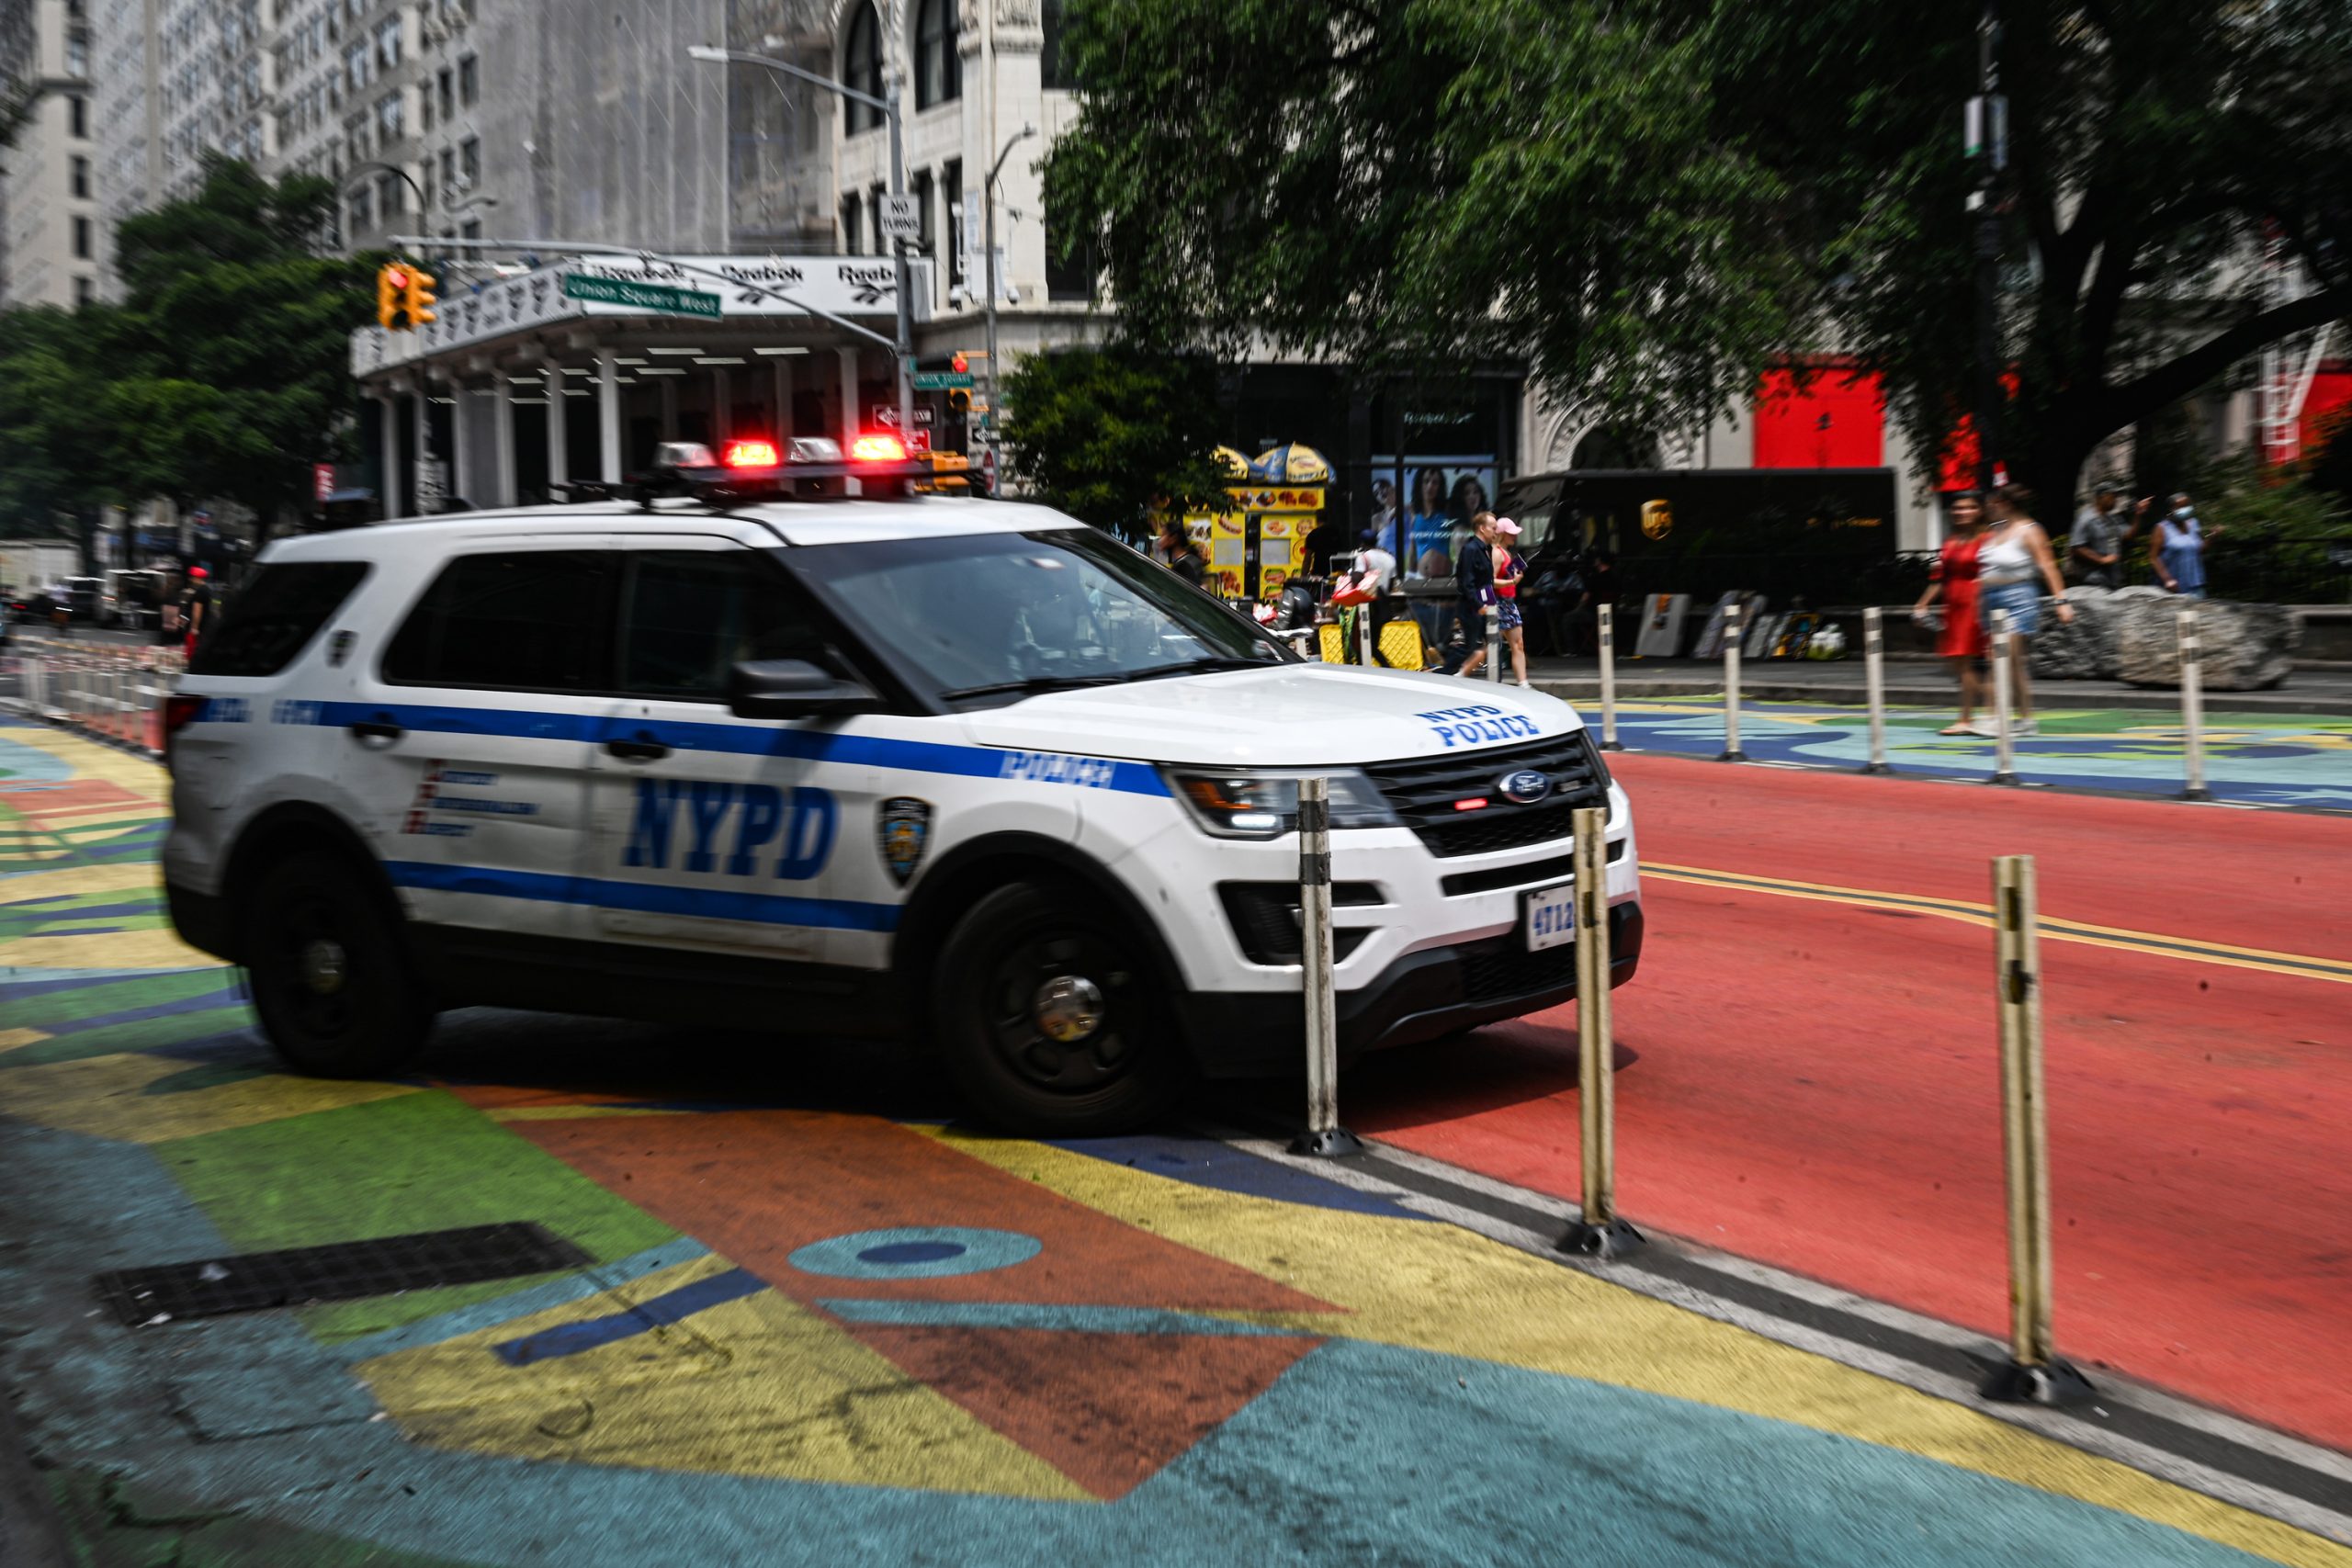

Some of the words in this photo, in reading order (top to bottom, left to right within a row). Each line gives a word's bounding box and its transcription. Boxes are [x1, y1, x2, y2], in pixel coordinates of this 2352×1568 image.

[890, 199, 910, 215] NO
[882, 216, 919, 231] TURNS
[720, 264, 804, 281] Reebok
[569, 279, 617, 299] Union
[618, 286, 677, 308] Square
[678, 292, 717, 314] West
[1414, 705, 1502, 723] NYPD
[1430, 715, 1542, 747] POLICE
[1515, 774, 1545, 791] Ford
[620, 777, 842, 881] NYPD
